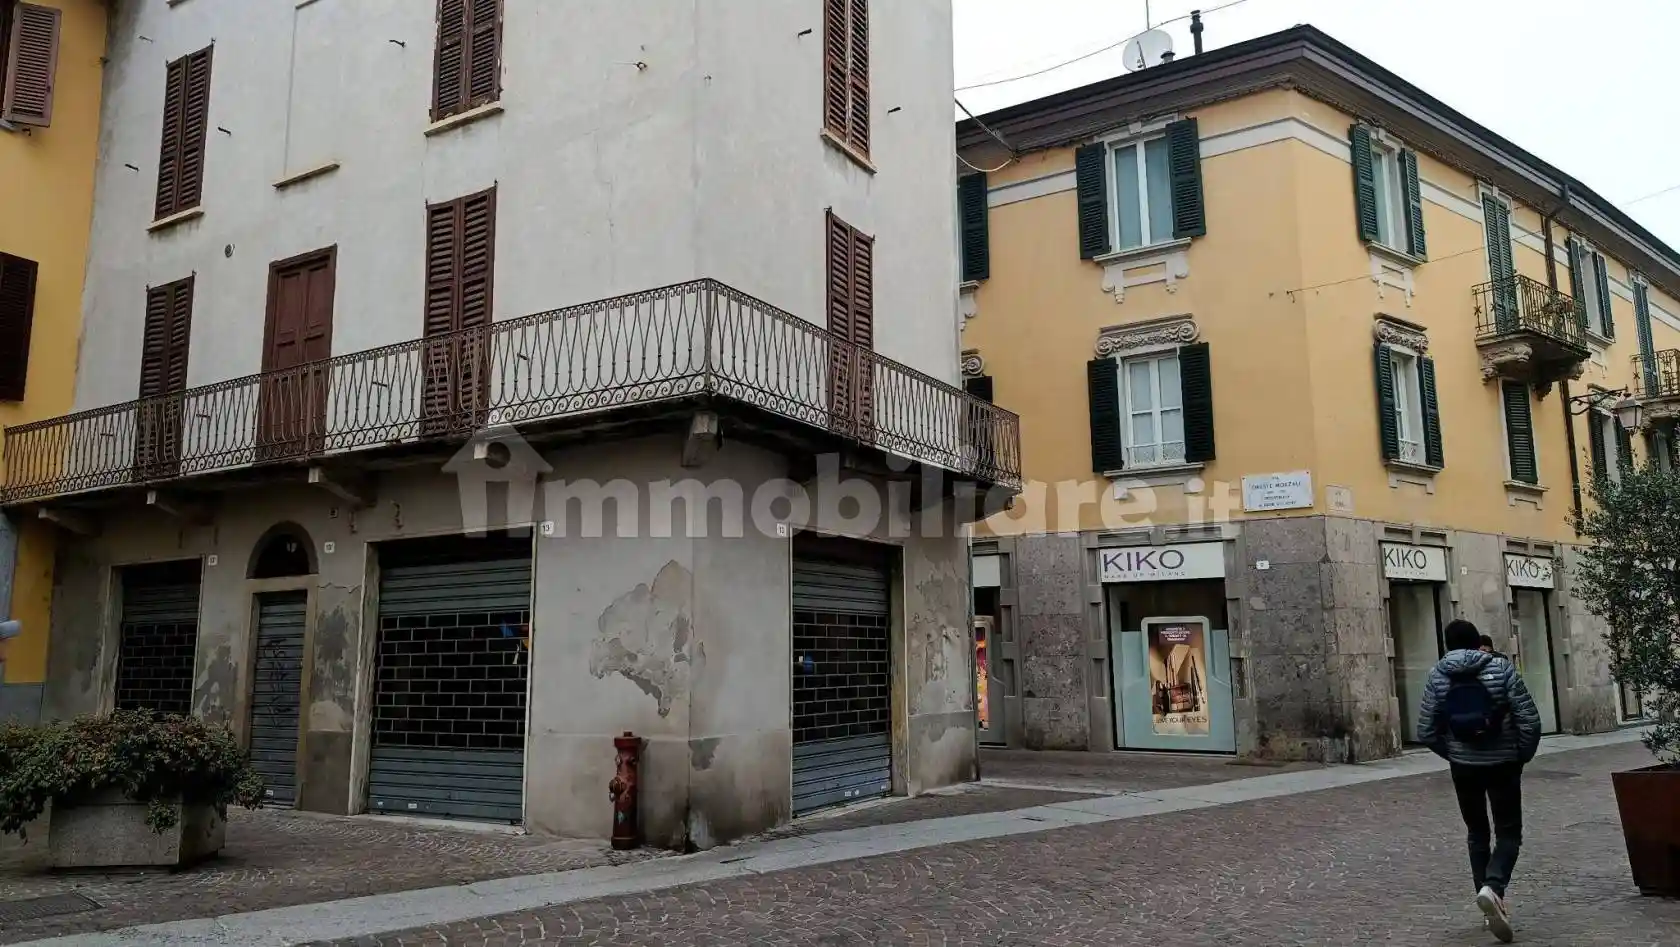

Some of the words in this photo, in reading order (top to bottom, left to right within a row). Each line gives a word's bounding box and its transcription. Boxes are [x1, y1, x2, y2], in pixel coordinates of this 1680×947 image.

[1103, 549, 1185, 572] KIKO
[1383, 547, 1427, 570] KIKO
[1505, 559, 1539, 578] KIKO
